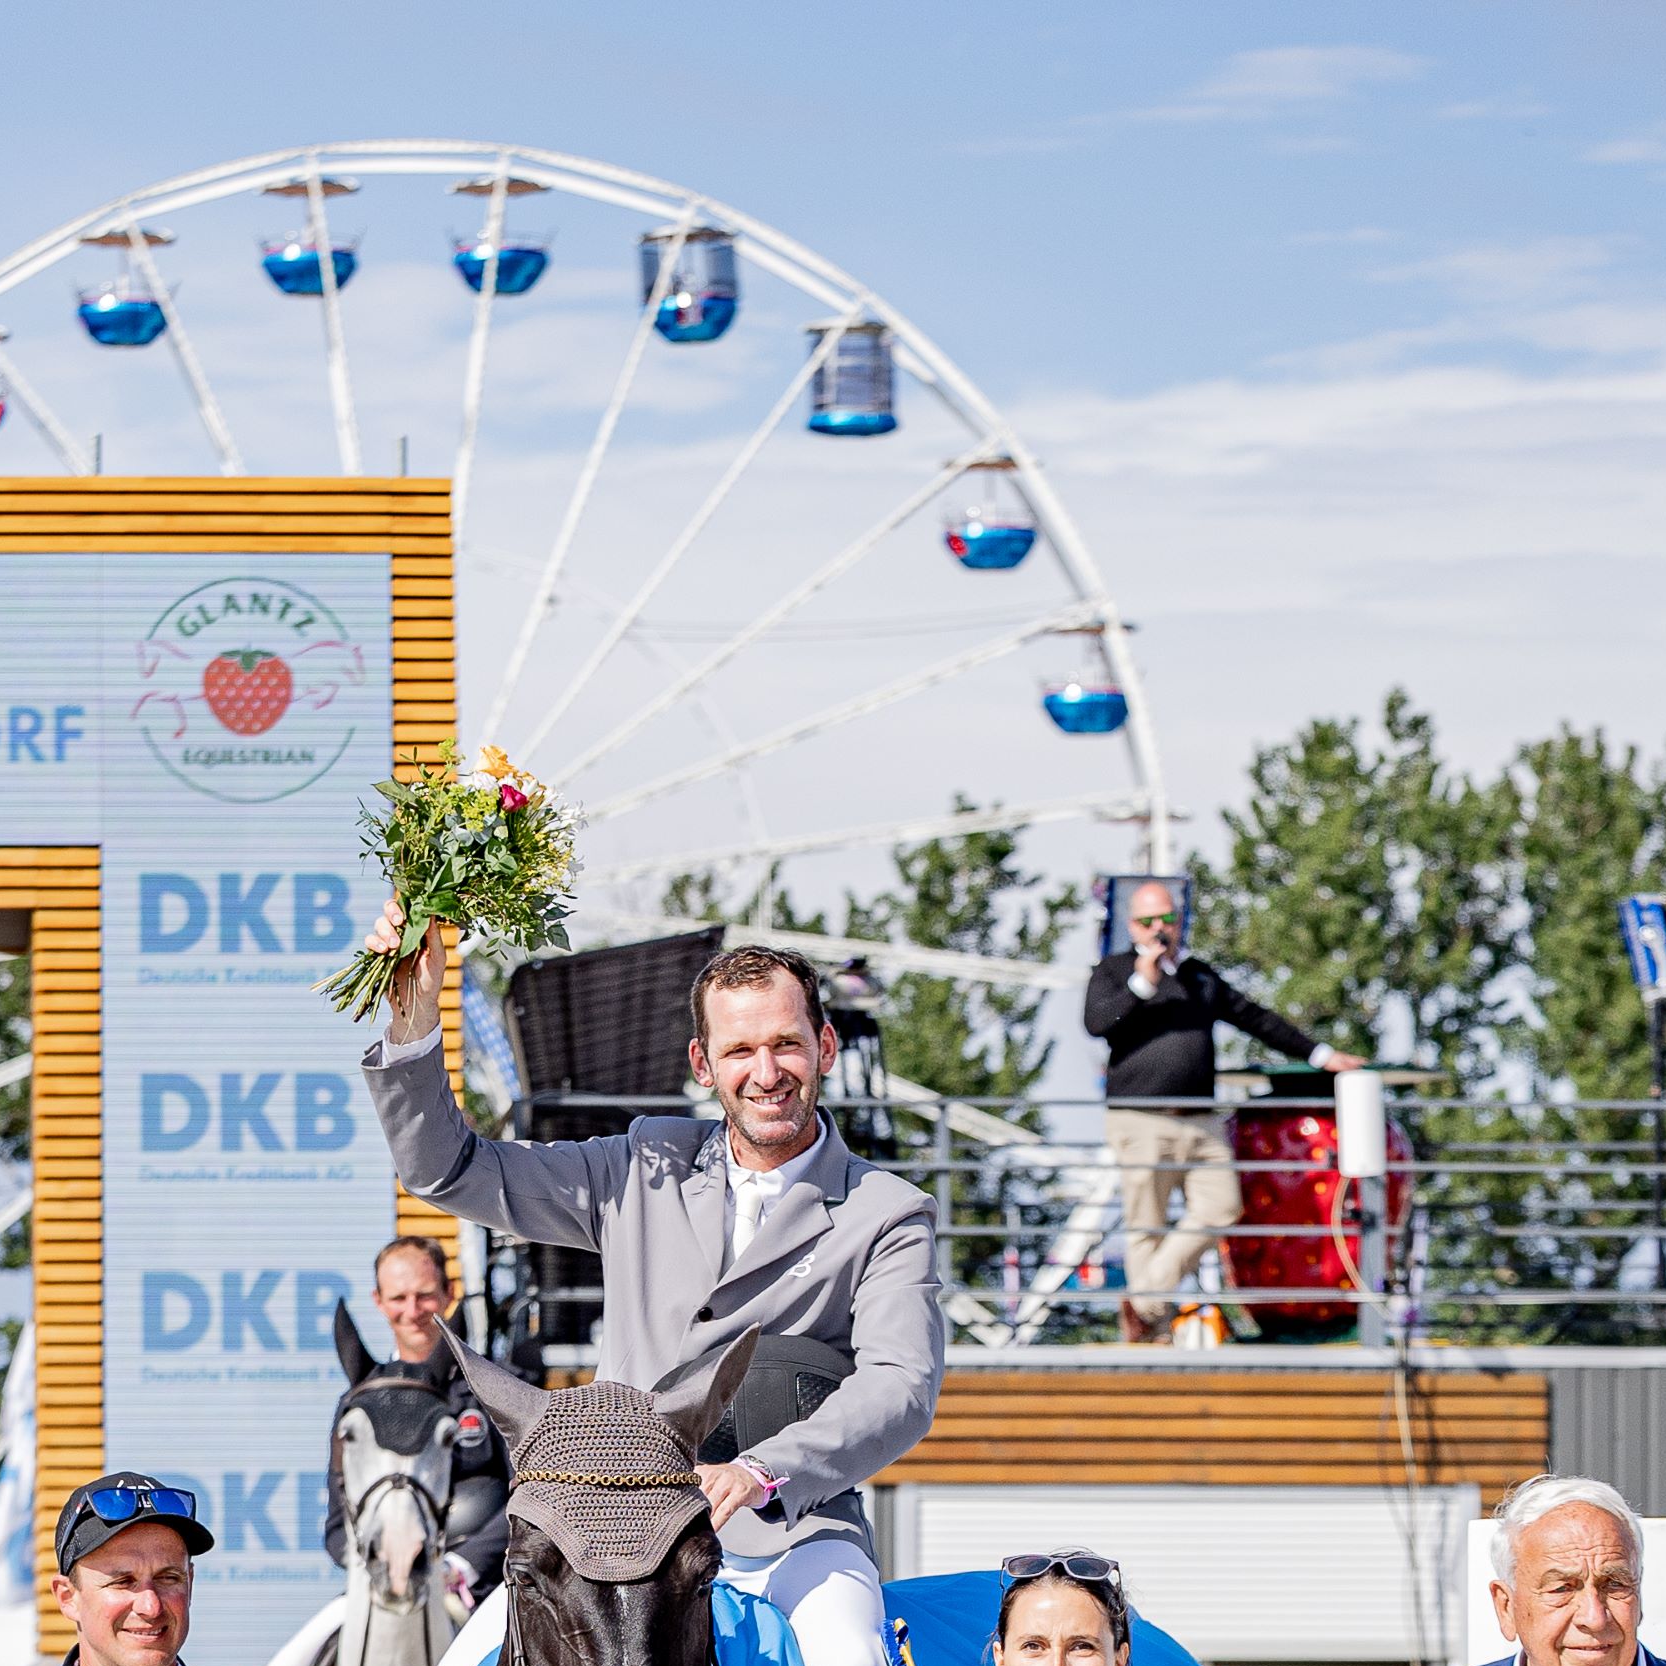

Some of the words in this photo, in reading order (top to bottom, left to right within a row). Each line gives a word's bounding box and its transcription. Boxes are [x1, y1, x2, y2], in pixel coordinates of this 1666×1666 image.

[175, 592, 317, 638] GLANTZ
[182, 747, 316, 769] EQUESTRIAN
[138, 873, 356, 954] DKB
[140, 1072, 357, 1152] DKB
[141, 1269, 354, 1354] DKB
